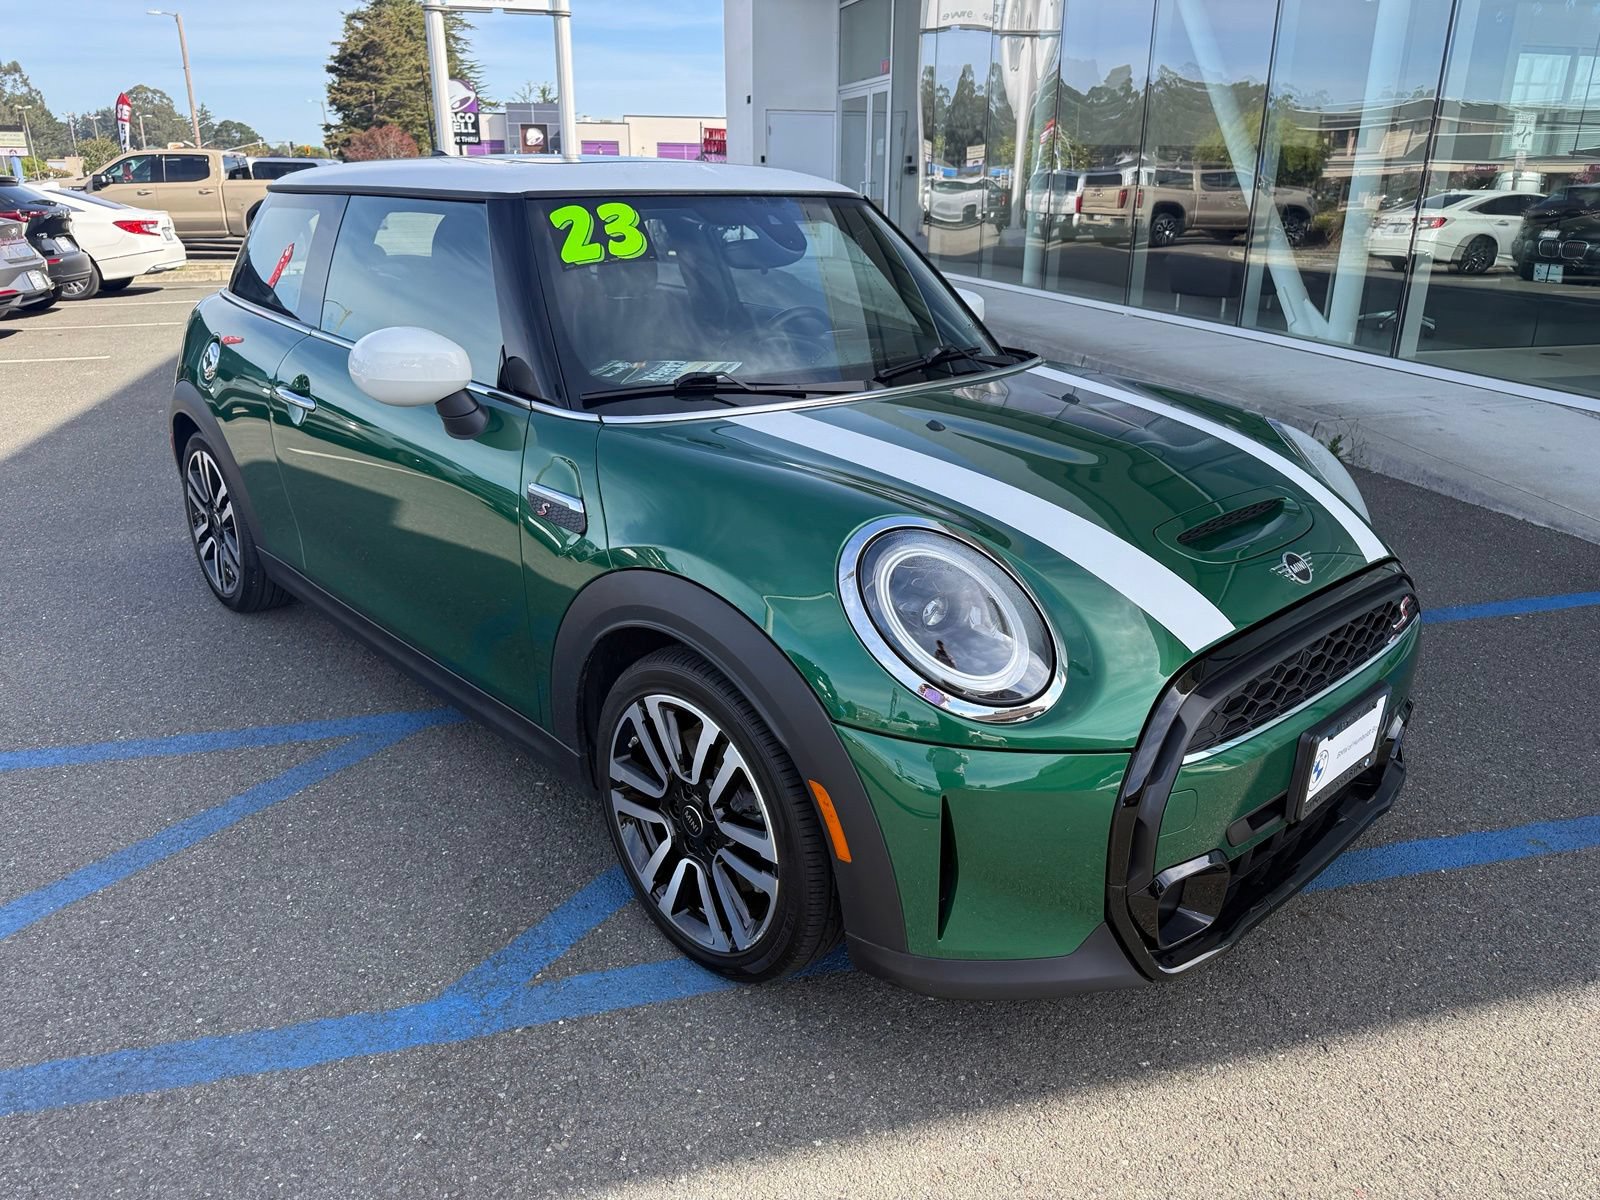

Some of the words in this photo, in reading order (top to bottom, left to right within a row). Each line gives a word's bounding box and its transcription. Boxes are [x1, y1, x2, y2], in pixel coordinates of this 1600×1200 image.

[451, 112, 475, 123] ACO
[453, 122, 476, 133] ELL
[549, 202, 648, 265] 23
[1289, 559, 1308, 574] MINI
[684, 811, 699, 832] MINI
